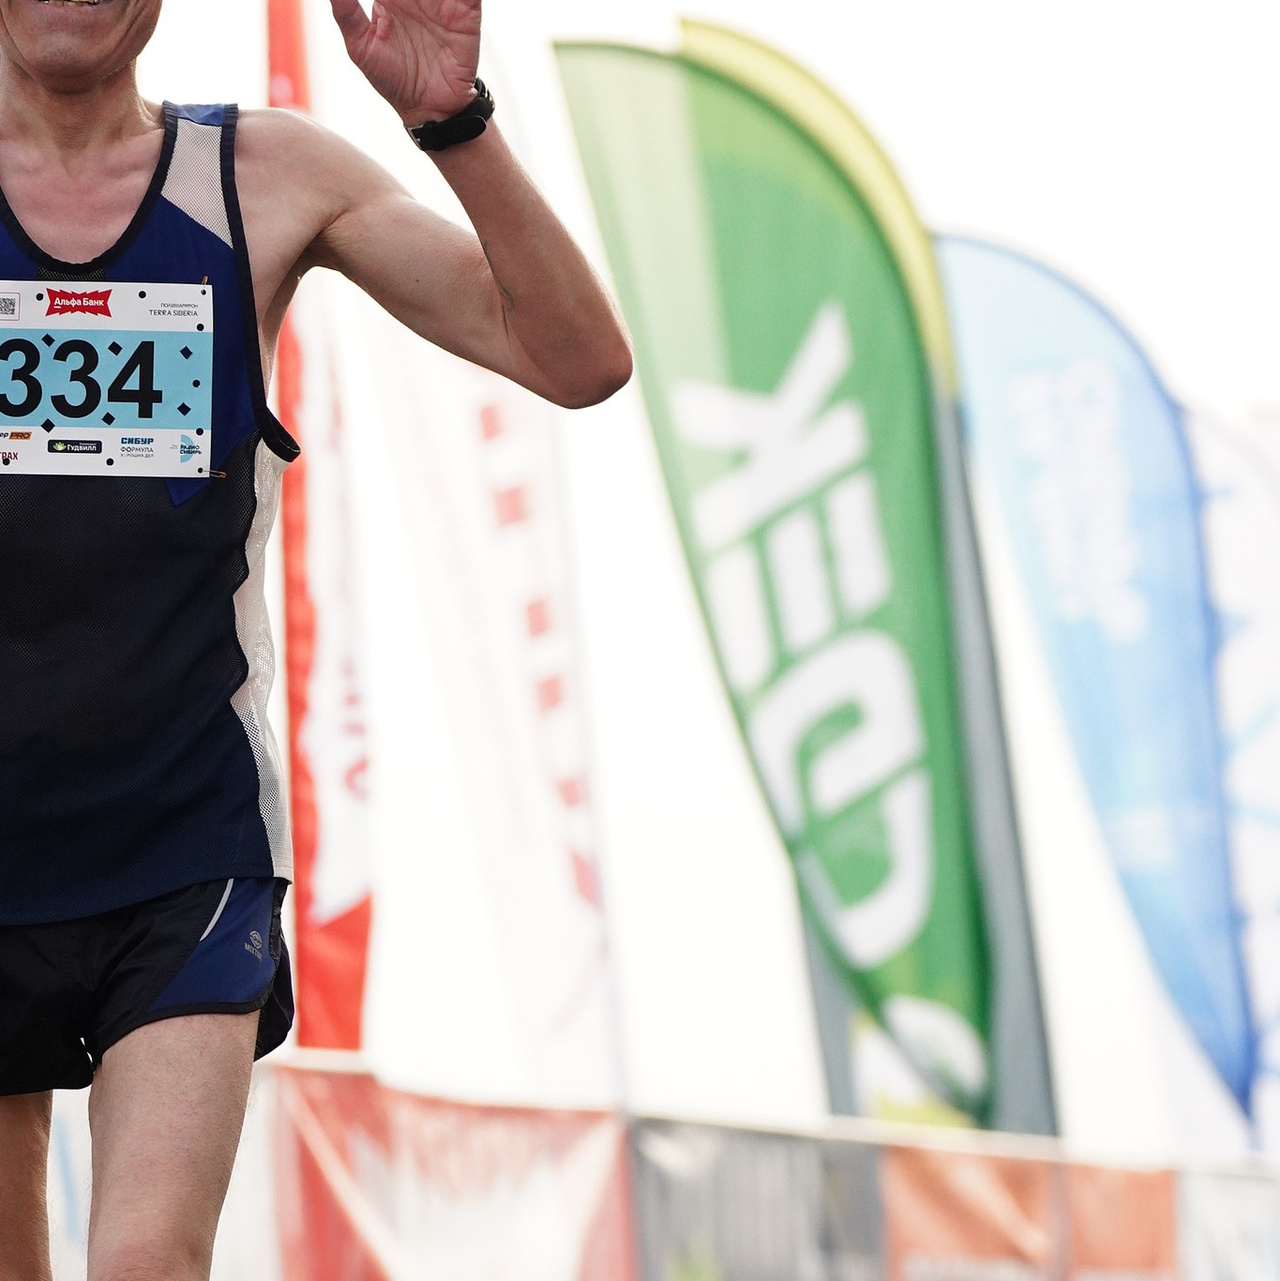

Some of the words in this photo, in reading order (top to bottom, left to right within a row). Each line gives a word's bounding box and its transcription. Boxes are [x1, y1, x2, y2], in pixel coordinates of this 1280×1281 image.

[54, 297, 82, 308] Альфа
[82, 297, 104, 306] Банк
[10, 431, 32, 440] PRO
[121, 437, 154, 445] СИБУР
